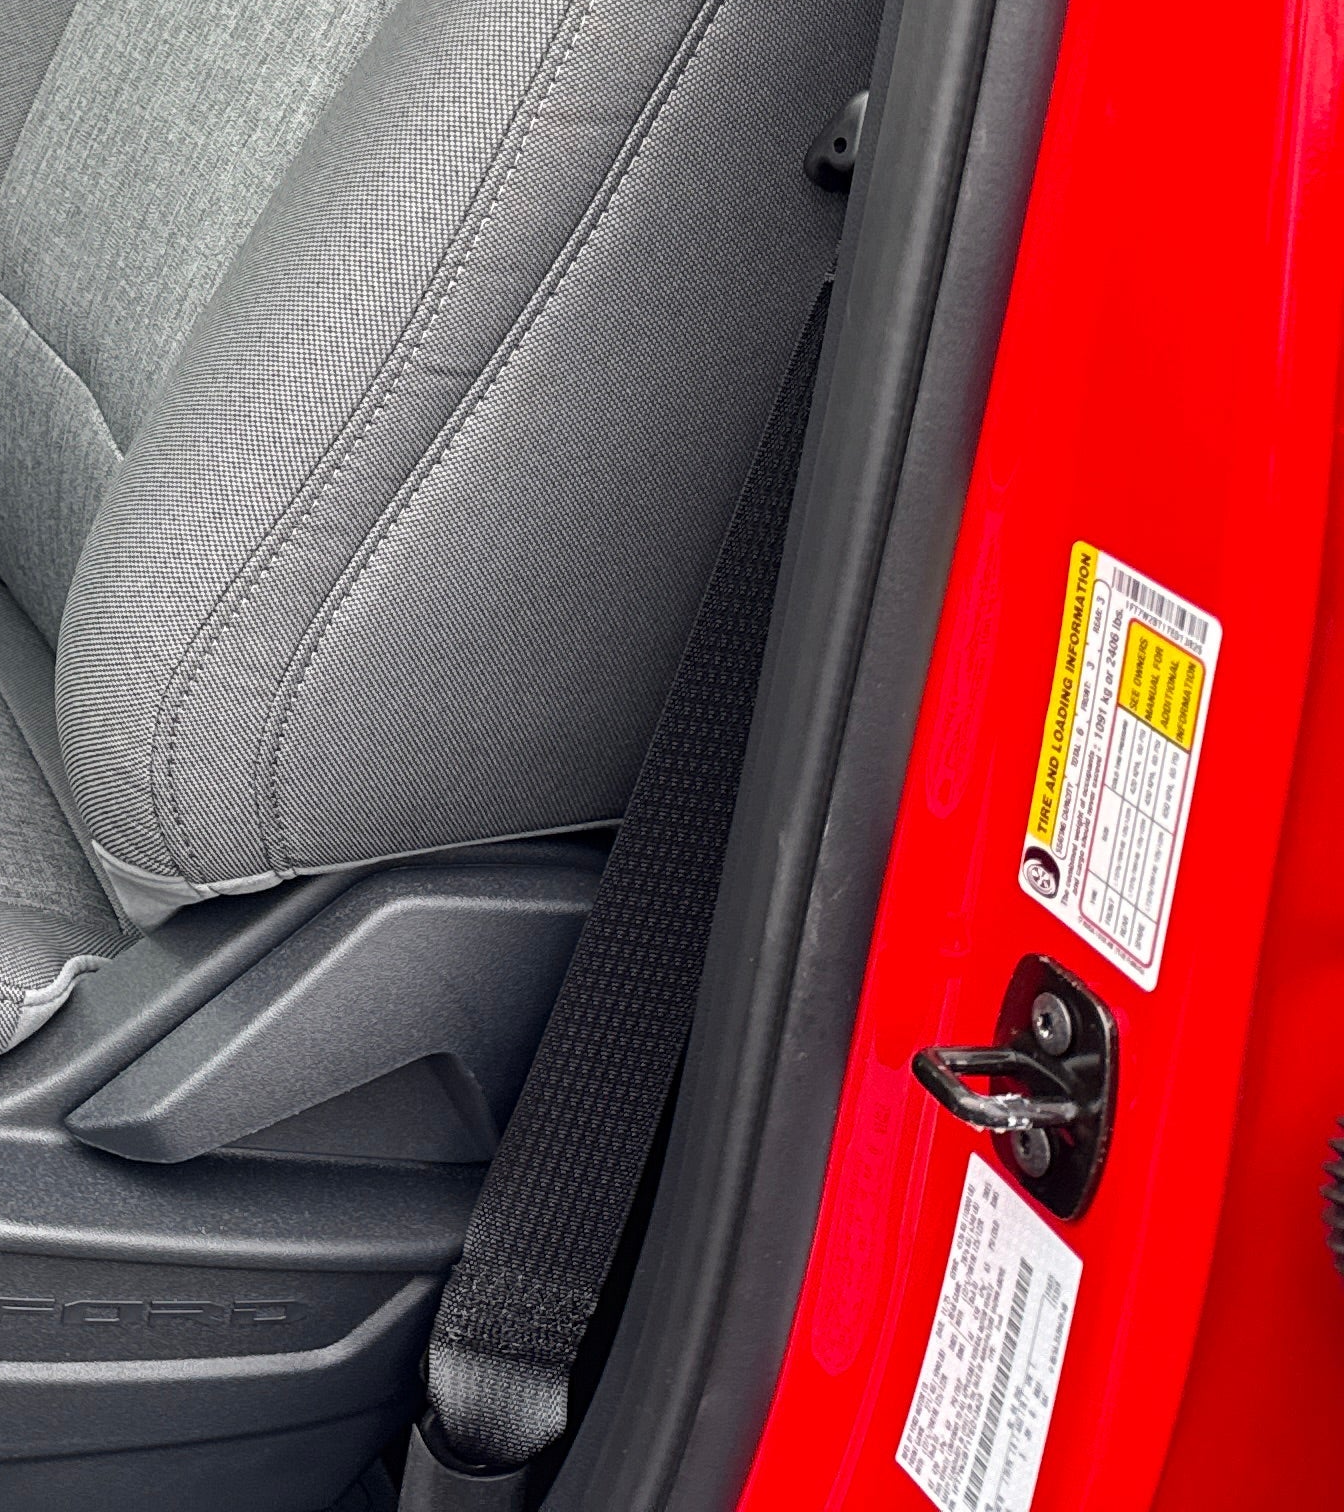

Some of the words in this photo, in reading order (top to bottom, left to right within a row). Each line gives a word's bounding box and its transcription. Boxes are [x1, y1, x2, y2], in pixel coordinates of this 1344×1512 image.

[1062, 550, 1093, 674] INFORMATION
[1085, 659, 1095, 671] 3
[1096, 594, 1105, 606] 3
[1111, 604, 1124, 631] lbs.
[1105, 630, 1120, 668] 2406
[1132, 635, 1149, 688] OWNERS
[1099, 685, 1113, 707] kg
[1103, 668, 1113, 686] or
[1128, 687, 1140, 711] SEE
[1143, 670, 1160, 722] MANUAL
[1152, 644, 1164, 671] FOR
[1159, 657, 1180, 730] ADDITIONAL
[1051, 673, 1073, 754] LOADING
[1093, 705, 1107, 742] 1091
[1174, 660, 1197, 744] INFORMATION
[1075, 724, 1084, 737] 6
[1044, 752, 1060, 794] AND
[1036, 791, 1052, 837] TIRE
